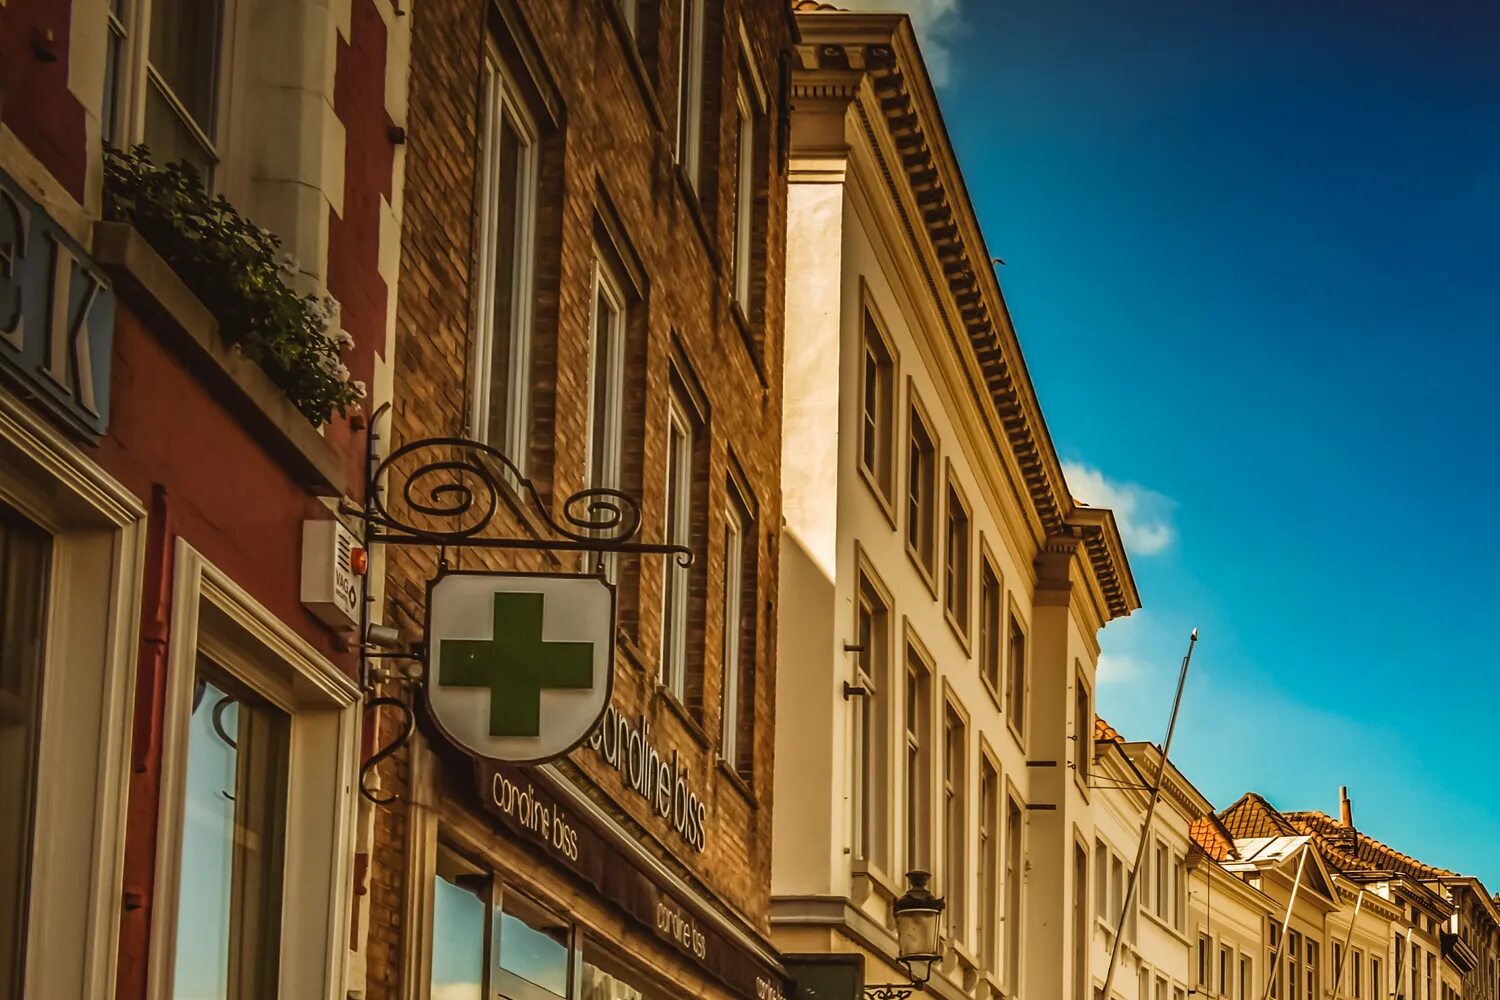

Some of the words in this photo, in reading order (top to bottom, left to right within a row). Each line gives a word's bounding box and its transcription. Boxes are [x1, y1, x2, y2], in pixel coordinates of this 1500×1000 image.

[493, 772, 549, 840] caroline
[553, 803, 578, 862] biss
[674, 749, 706, 854] biss
